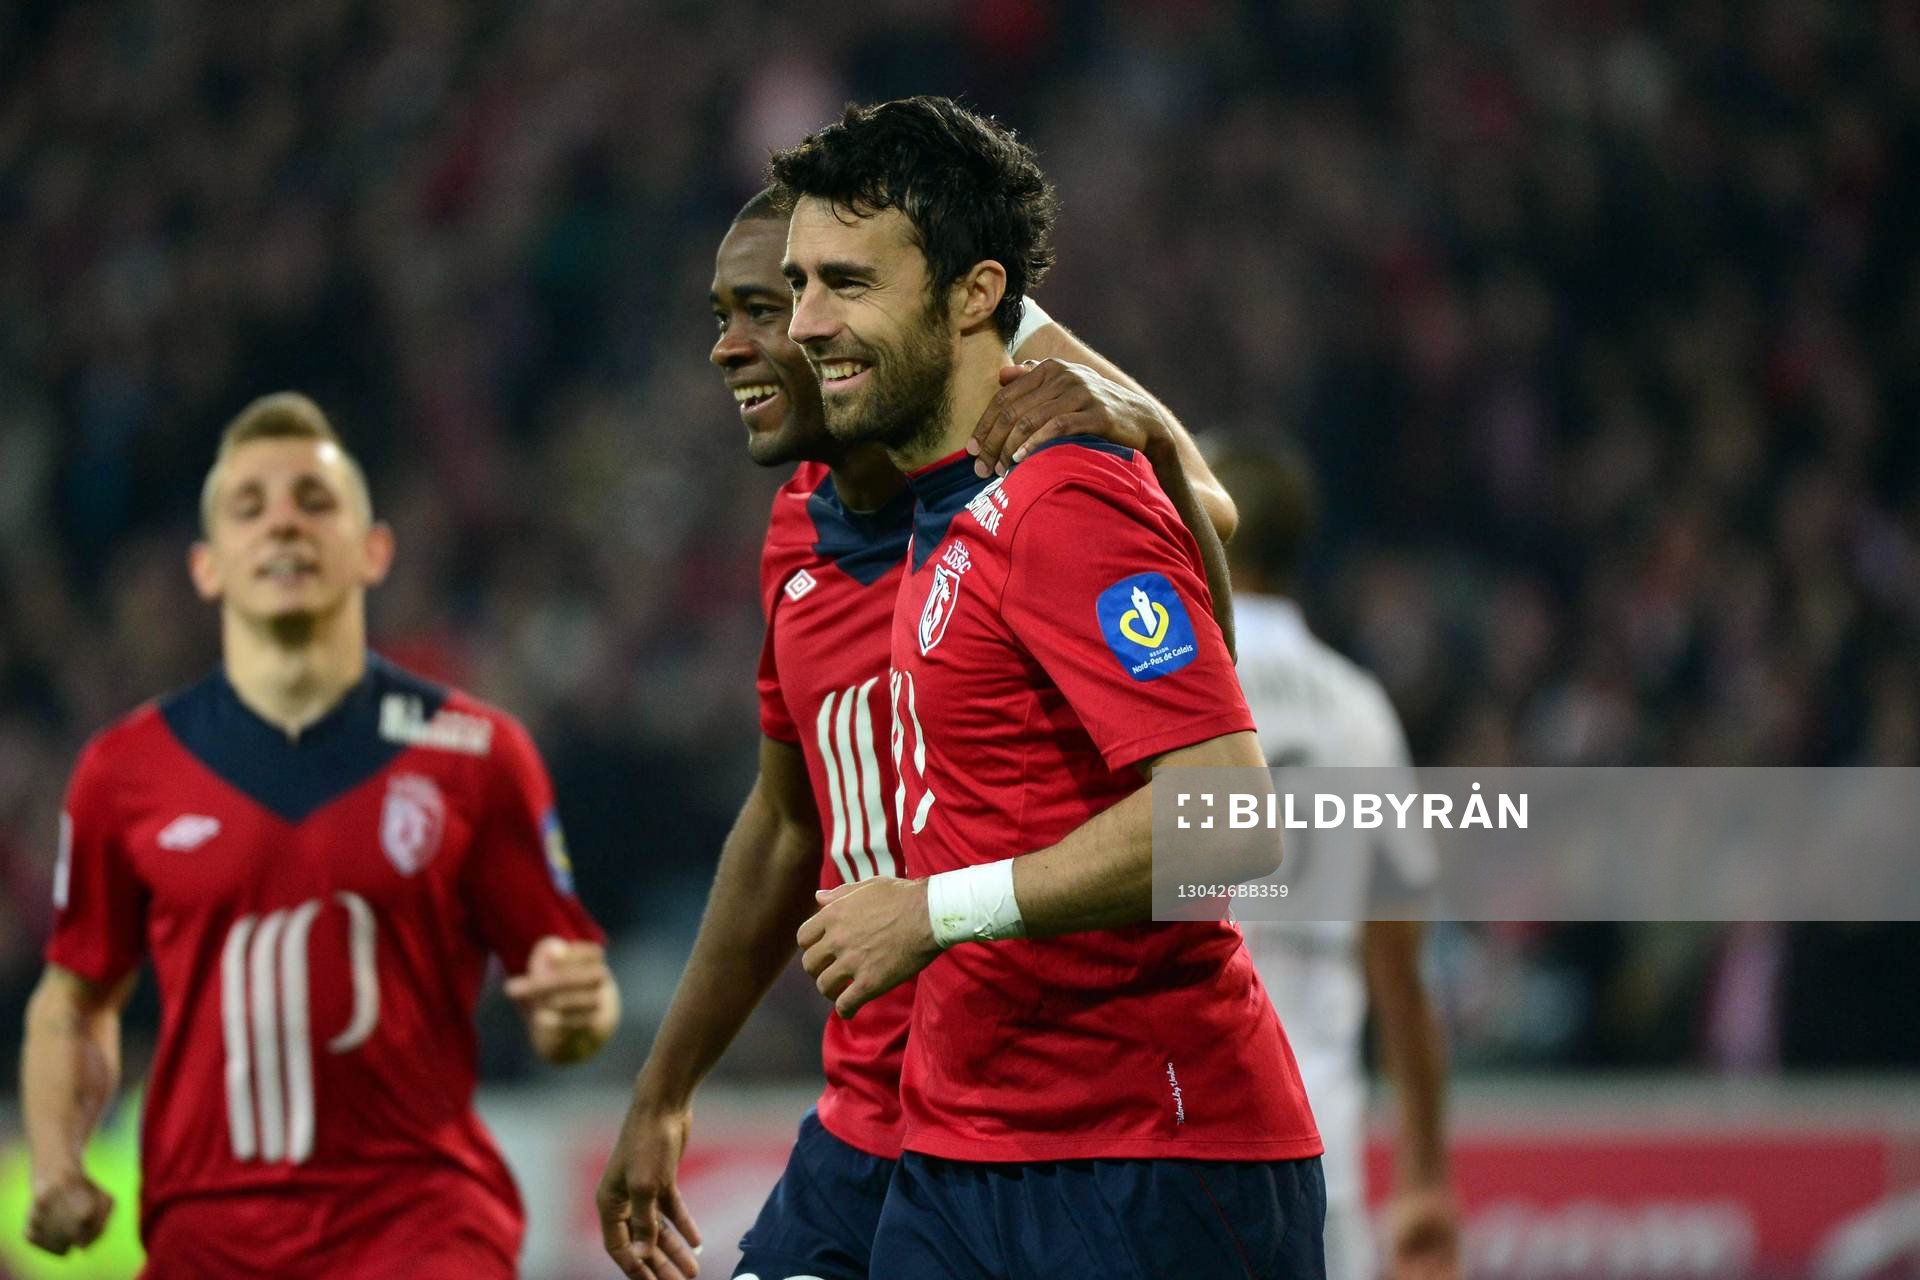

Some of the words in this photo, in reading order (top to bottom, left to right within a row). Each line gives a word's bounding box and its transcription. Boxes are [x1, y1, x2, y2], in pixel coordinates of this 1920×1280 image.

[942, 545, 972, 574] LOSC
[1132, 656, 1164, 674] Nord-Pas
[1163, 651, 1173, 661] de
[1172, 644, 1194, 657] Calais
